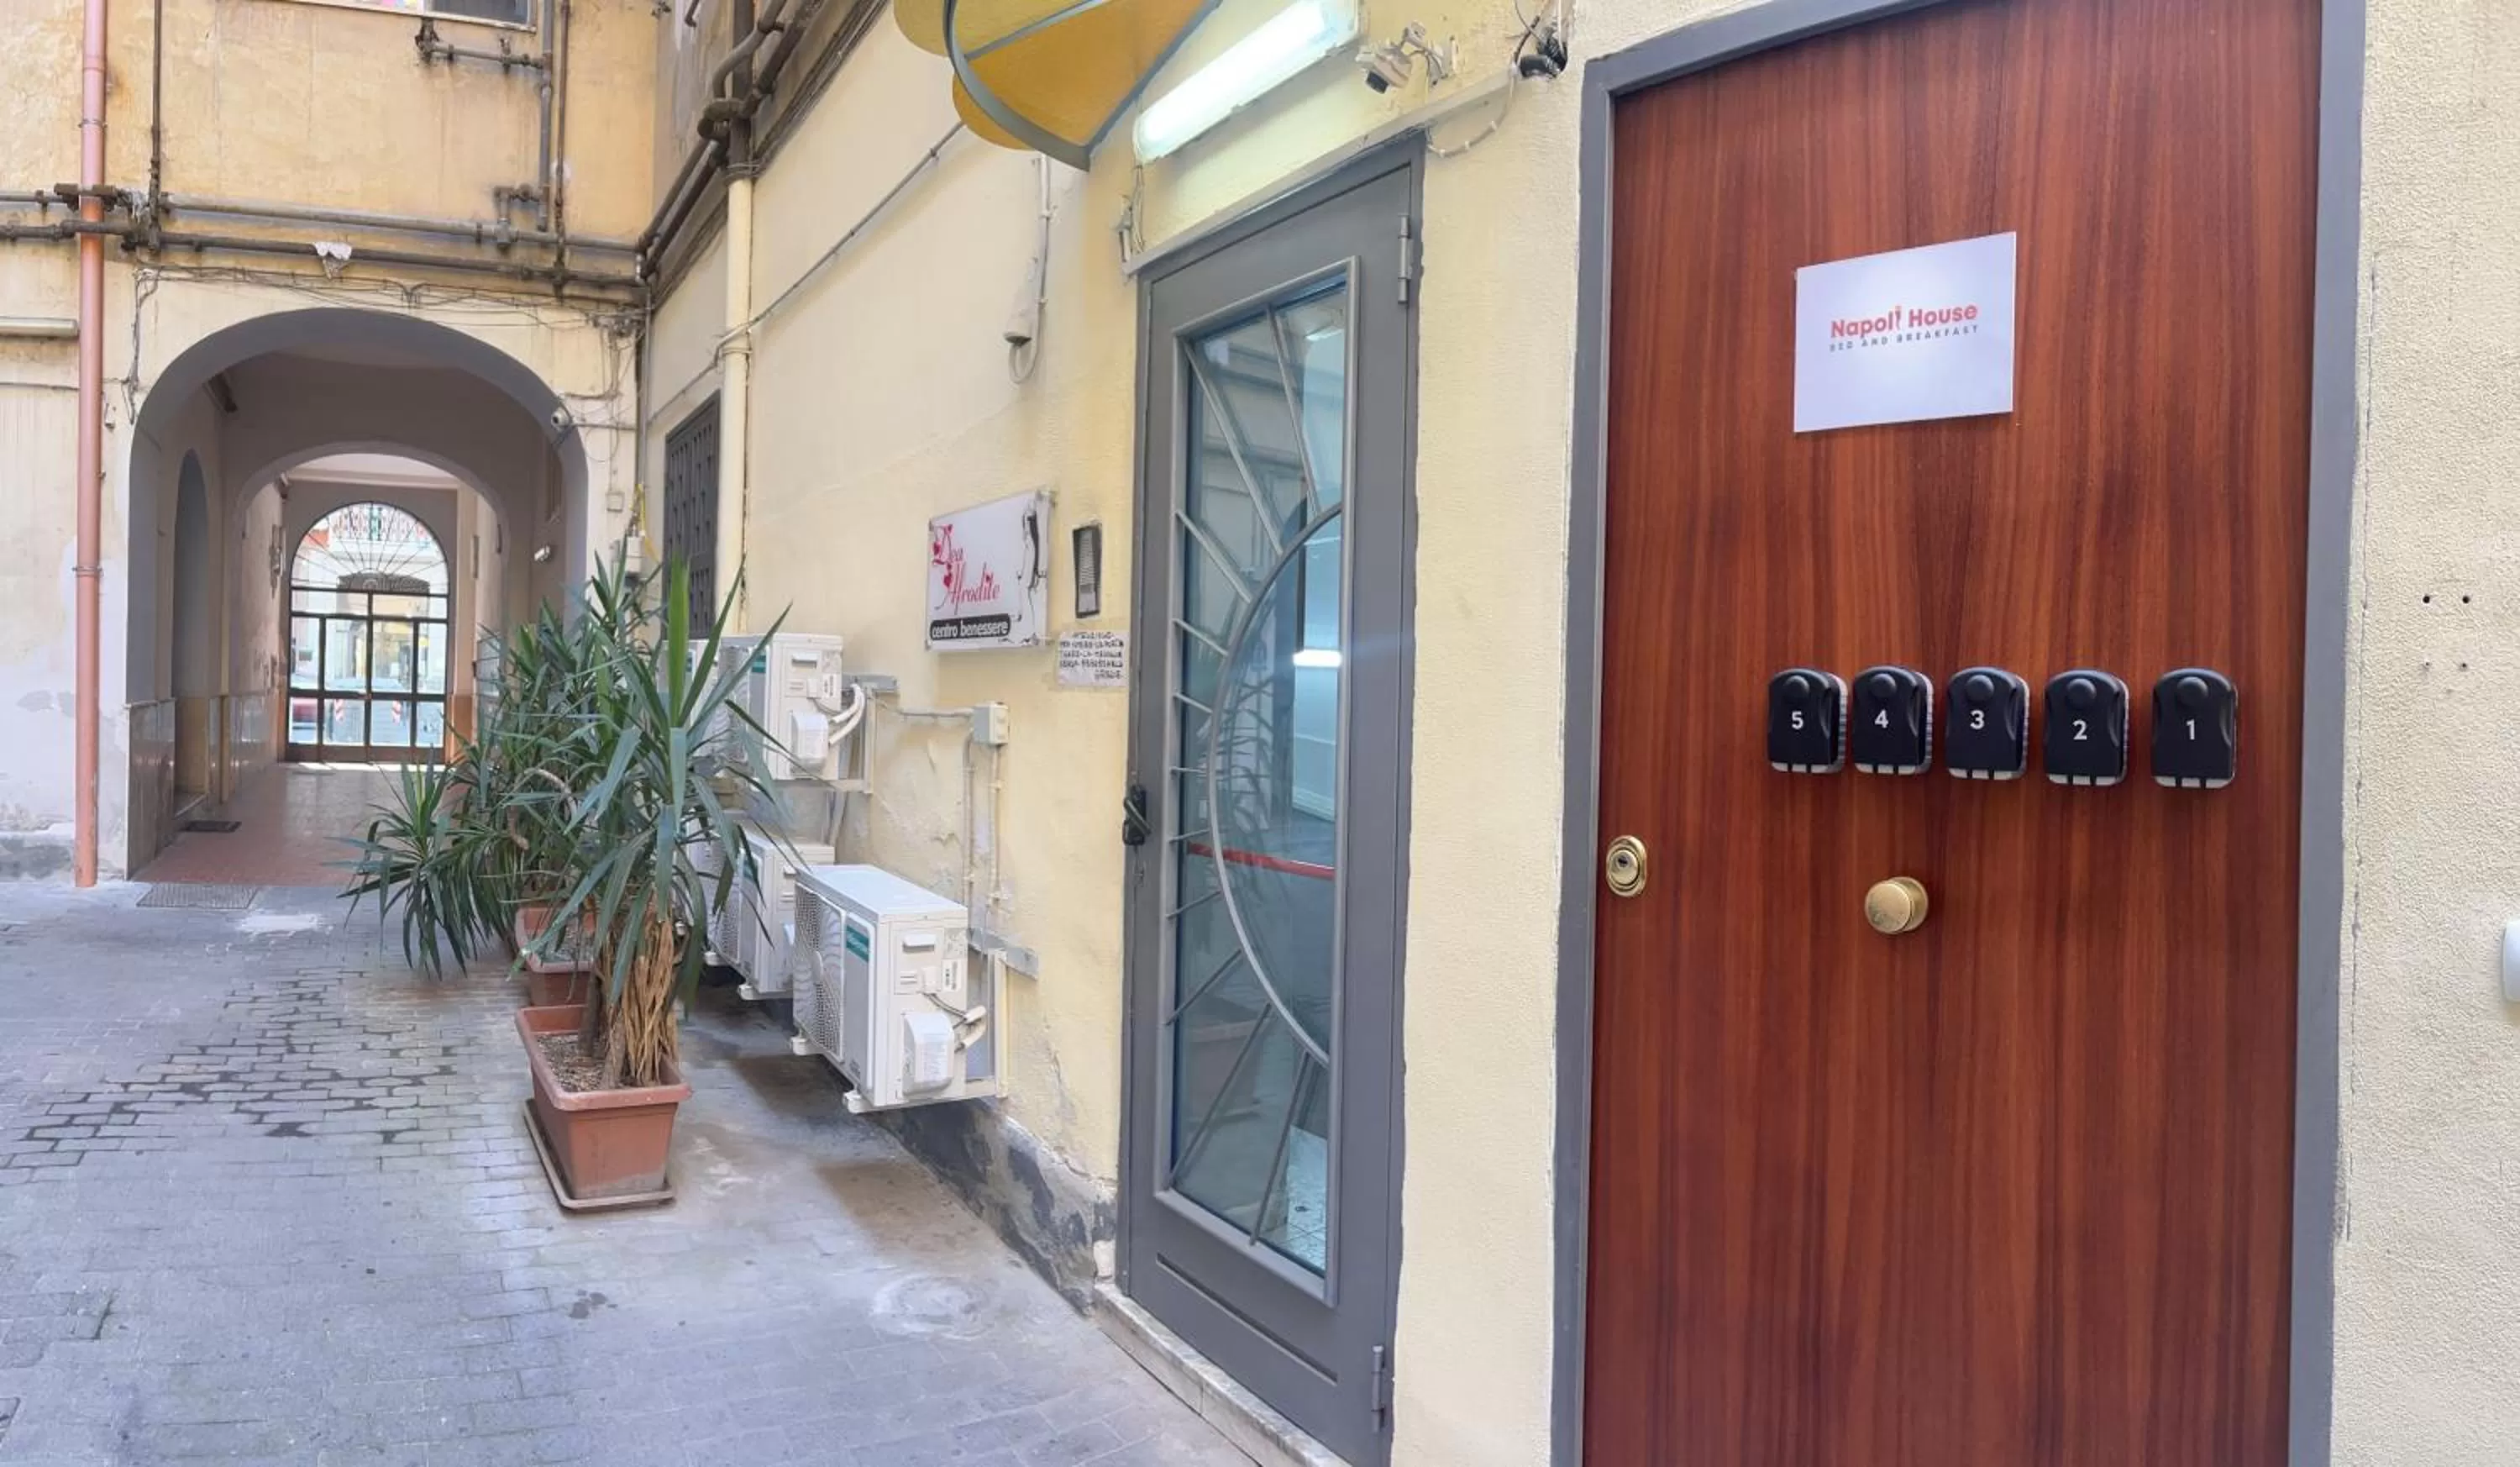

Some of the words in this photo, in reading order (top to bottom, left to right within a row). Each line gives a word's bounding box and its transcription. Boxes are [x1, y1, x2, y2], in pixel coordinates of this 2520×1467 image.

[1908, 305, 1979, 329] House
[1830, 340, 1854, 353] BED
[1861, 336, 1889, 348] AND
[1896, 324, 1979, 344] BREAKFAST
[932, 623, 958, 639] centro
[960, 620, 1010, 636] benessere
[1791, 711, 1804, 730] 5
[1874, 709, 1889, 728] 4
[1970, 710, 1985, 730] 3
[2073, 719, 2088, 740] 2
[2185, 720, 2196, 740] 1
